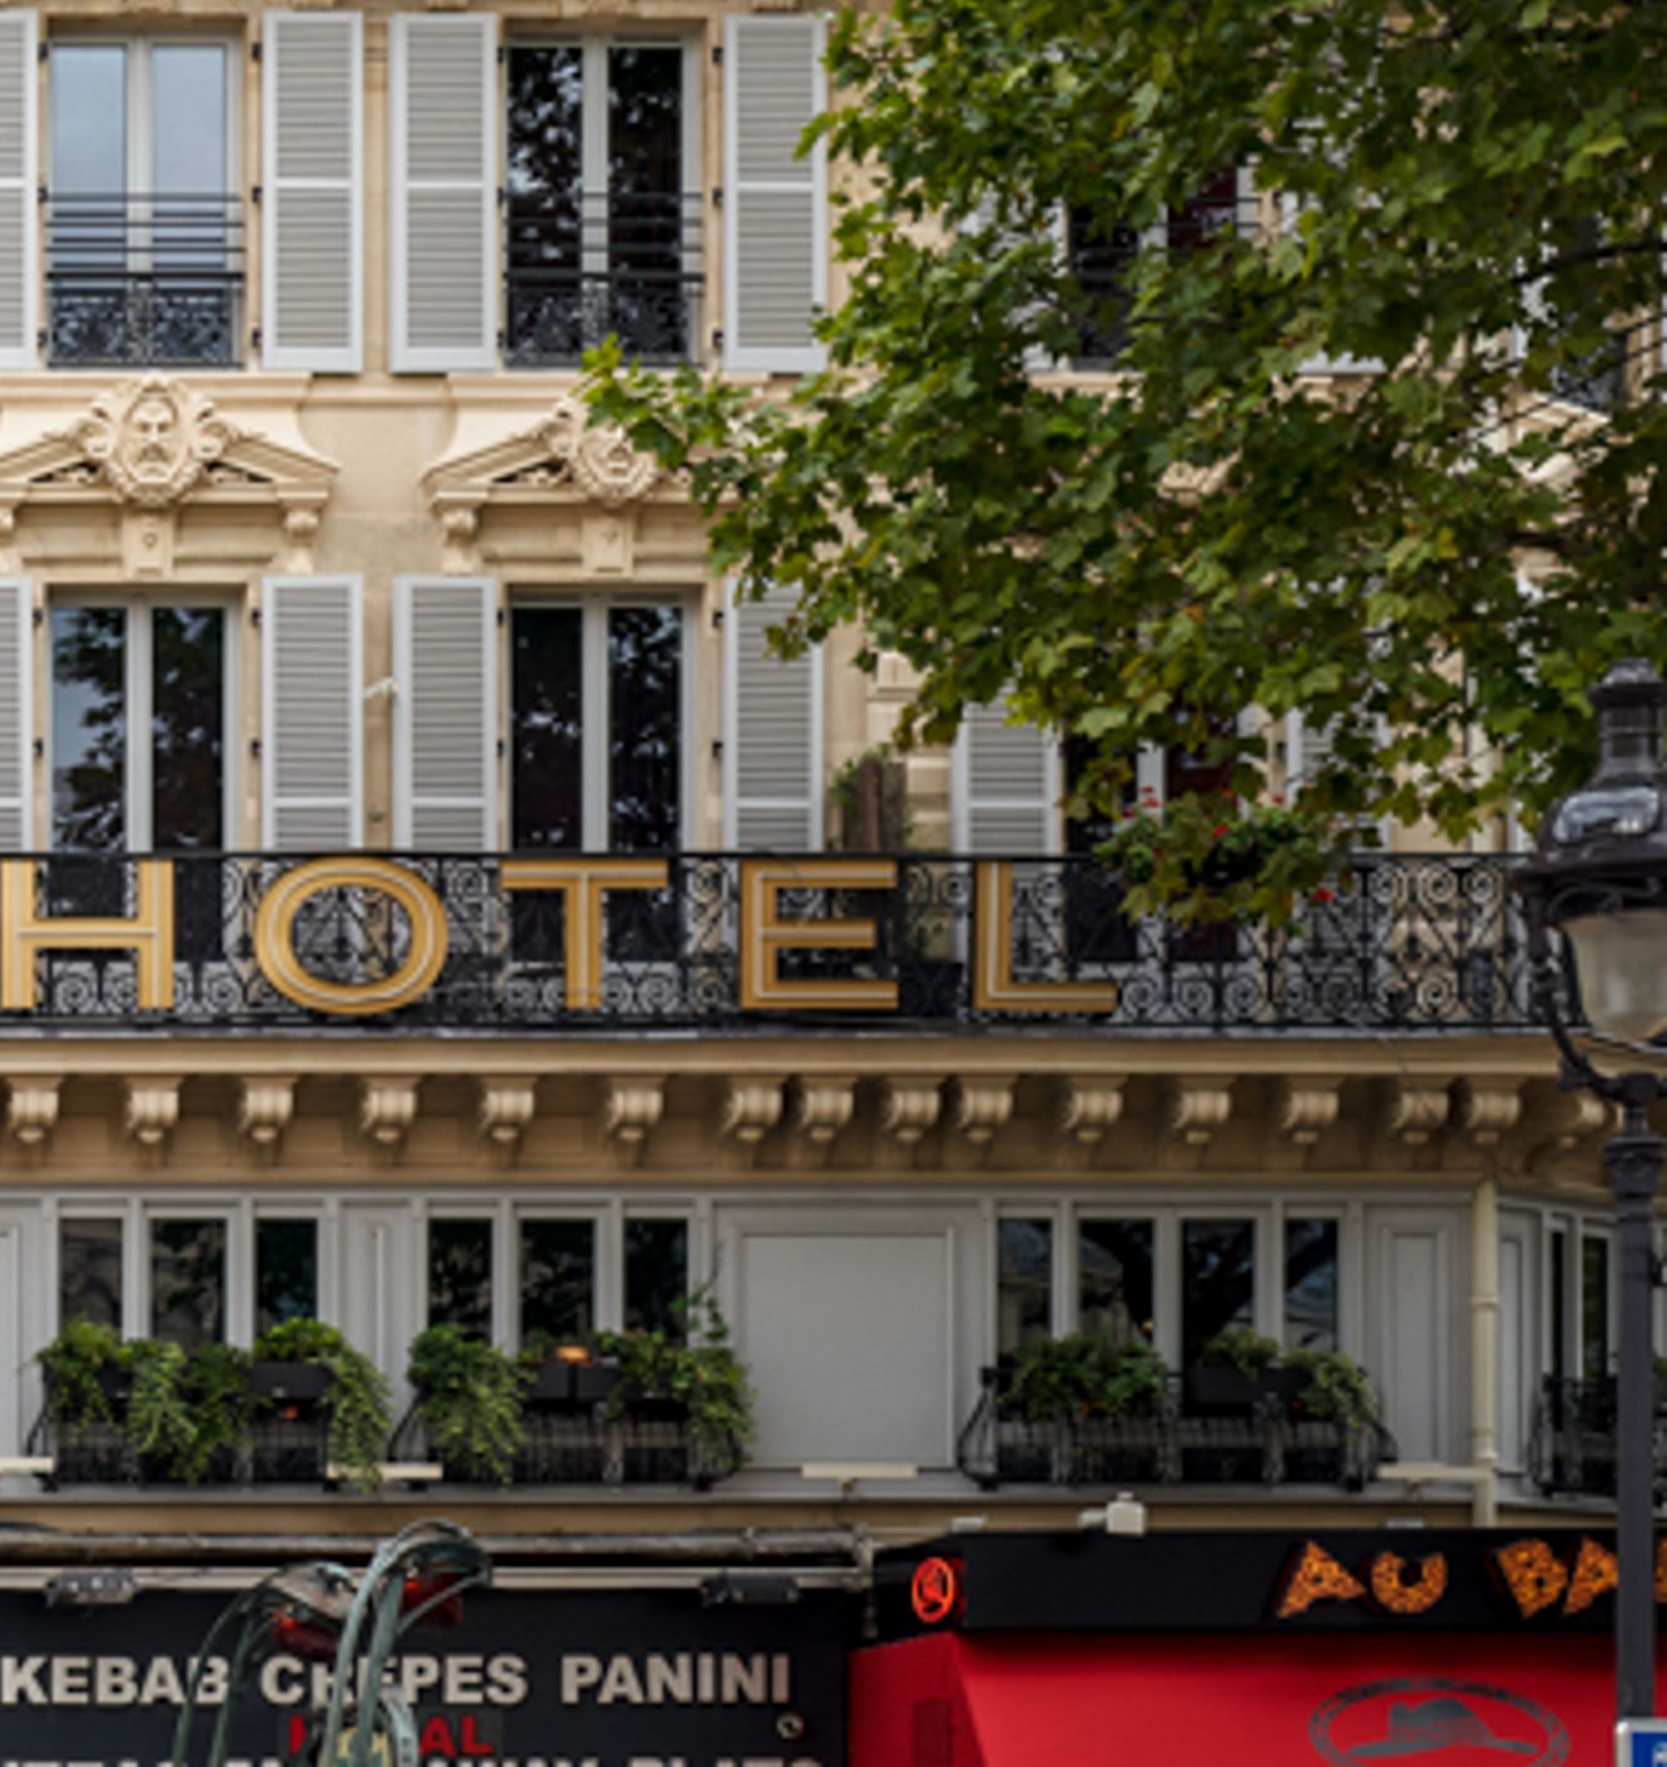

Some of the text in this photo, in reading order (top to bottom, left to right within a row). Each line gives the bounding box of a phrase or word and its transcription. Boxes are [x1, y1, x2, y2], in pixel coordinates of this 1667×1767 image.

[1277, 1539, 1450, 1619] AU
[0, 1655, 229, 1705] KEBAB
[560, 1653, 790, 1704] PANINI
